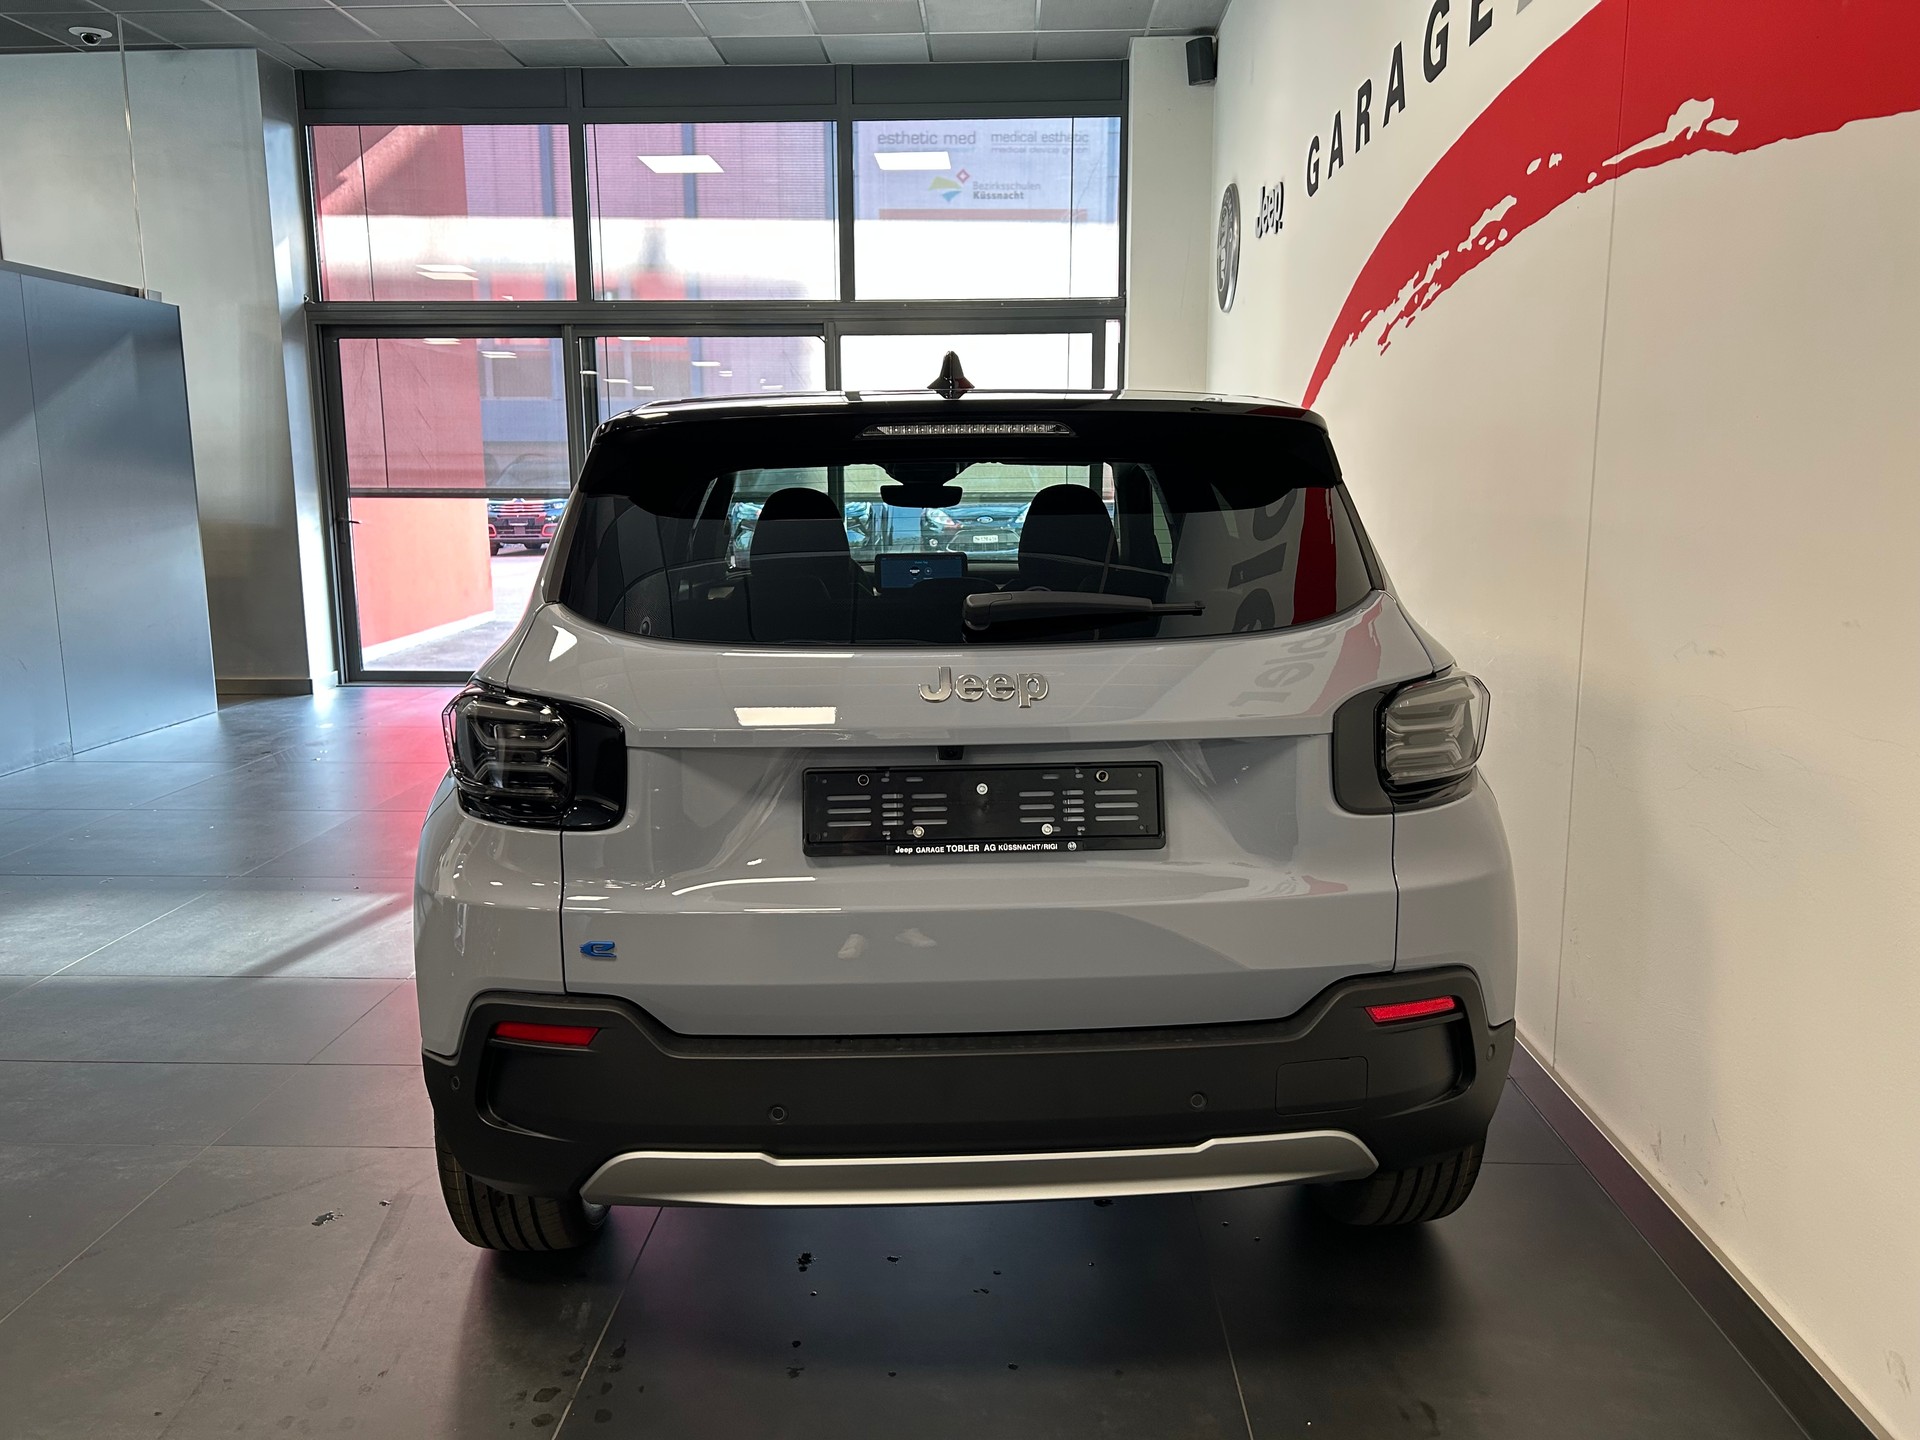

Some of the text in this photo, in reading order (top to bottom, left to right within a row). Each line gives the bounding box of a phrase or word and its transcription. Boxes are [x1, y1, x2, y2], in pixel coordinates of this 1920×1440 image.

[877, 130, 976, 145] esthetic med
[991, 130, 1037, 143] medical
[972, 181, 1041, 191] Bezirksschulen
[973, 190, 1024, 200] Küssnacht
[1255, 181, 1285, 239] Jeep
[918, 666, 1049, 709] Jeep
[894, 842, 1058, 855] Jeep GARAGE TOBLER AG KÜSSNACHT/RIGI
